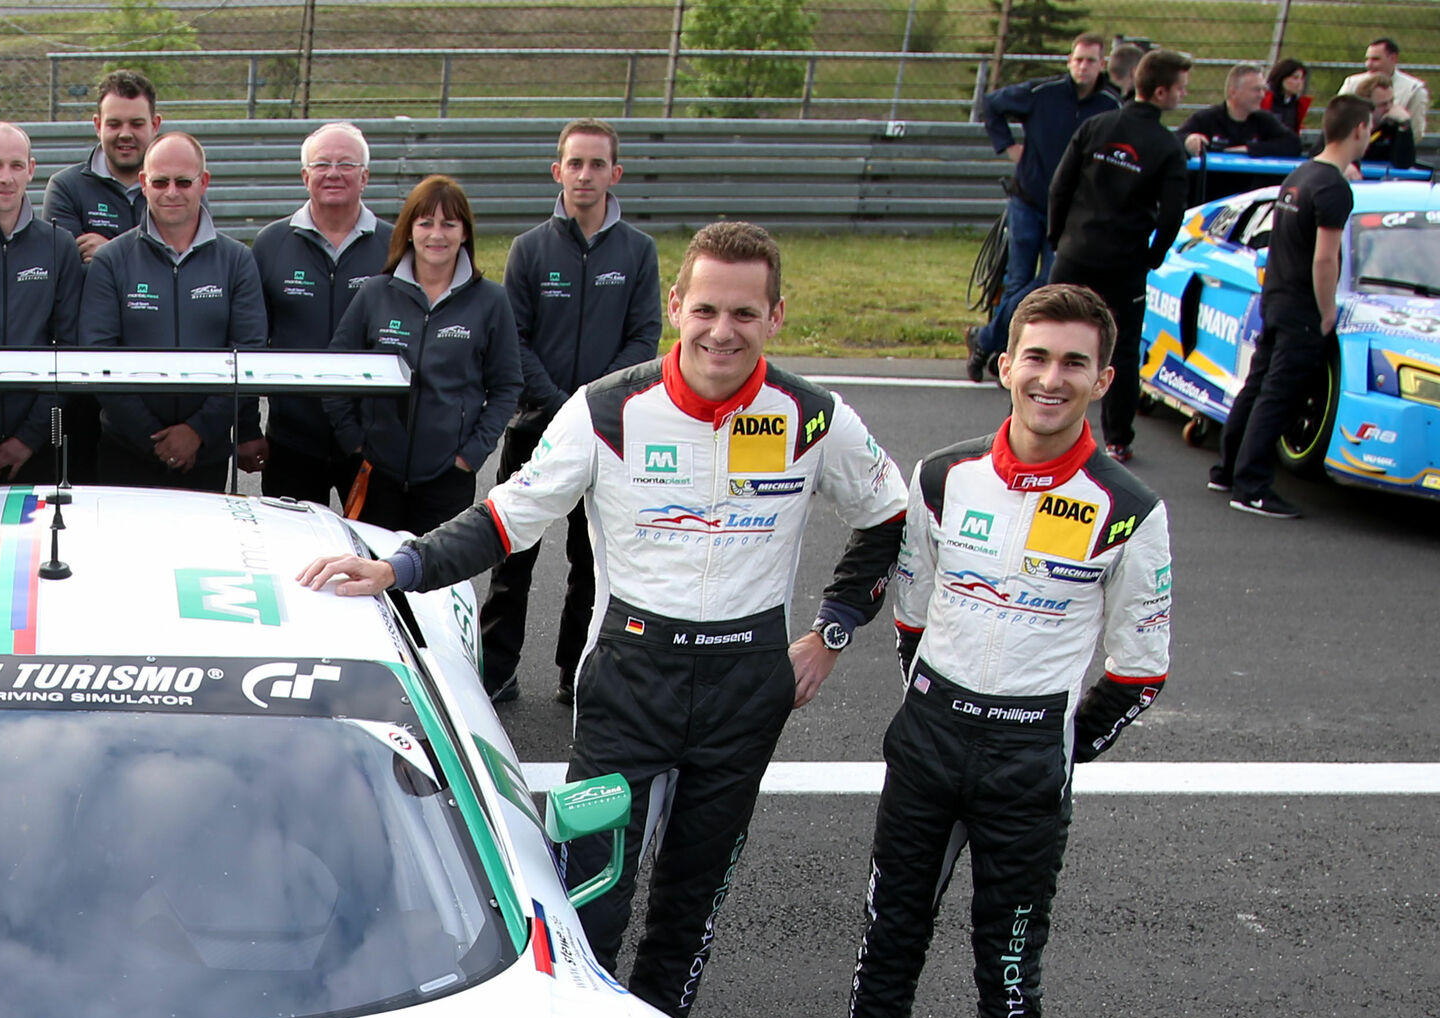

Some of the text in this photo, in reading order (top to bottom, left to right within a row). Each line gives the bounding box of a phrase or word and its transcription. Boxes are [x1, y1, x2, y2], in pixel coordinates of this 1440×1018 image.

[732, 415, 786, 437] ADAC
[804, 410, 826, 444] P1
[632, 475, 693, 486] montaplast
[757, 479, 806, 494] MICHELIN
[725, 511, 778, 528] Land
[1038, 496, 1096, 525] ADAC
[635, 528, 774, 546] Motorsport
[1107, 514, 1136, 544] P1
[946, 538, 999, 558] montaplast
[1051, 565, 1102, 579] MICHELIN
[941, 591, 1065, 627] Motorsport
[1015, 590, 1072, 611] Land
[694, 629, 754, 648] Basseng
[13, 663, 205, 693] TURISMO
[71, 692, 194, 706] SIMULATOR
[986, 707, 1047, 724] Phillippi
